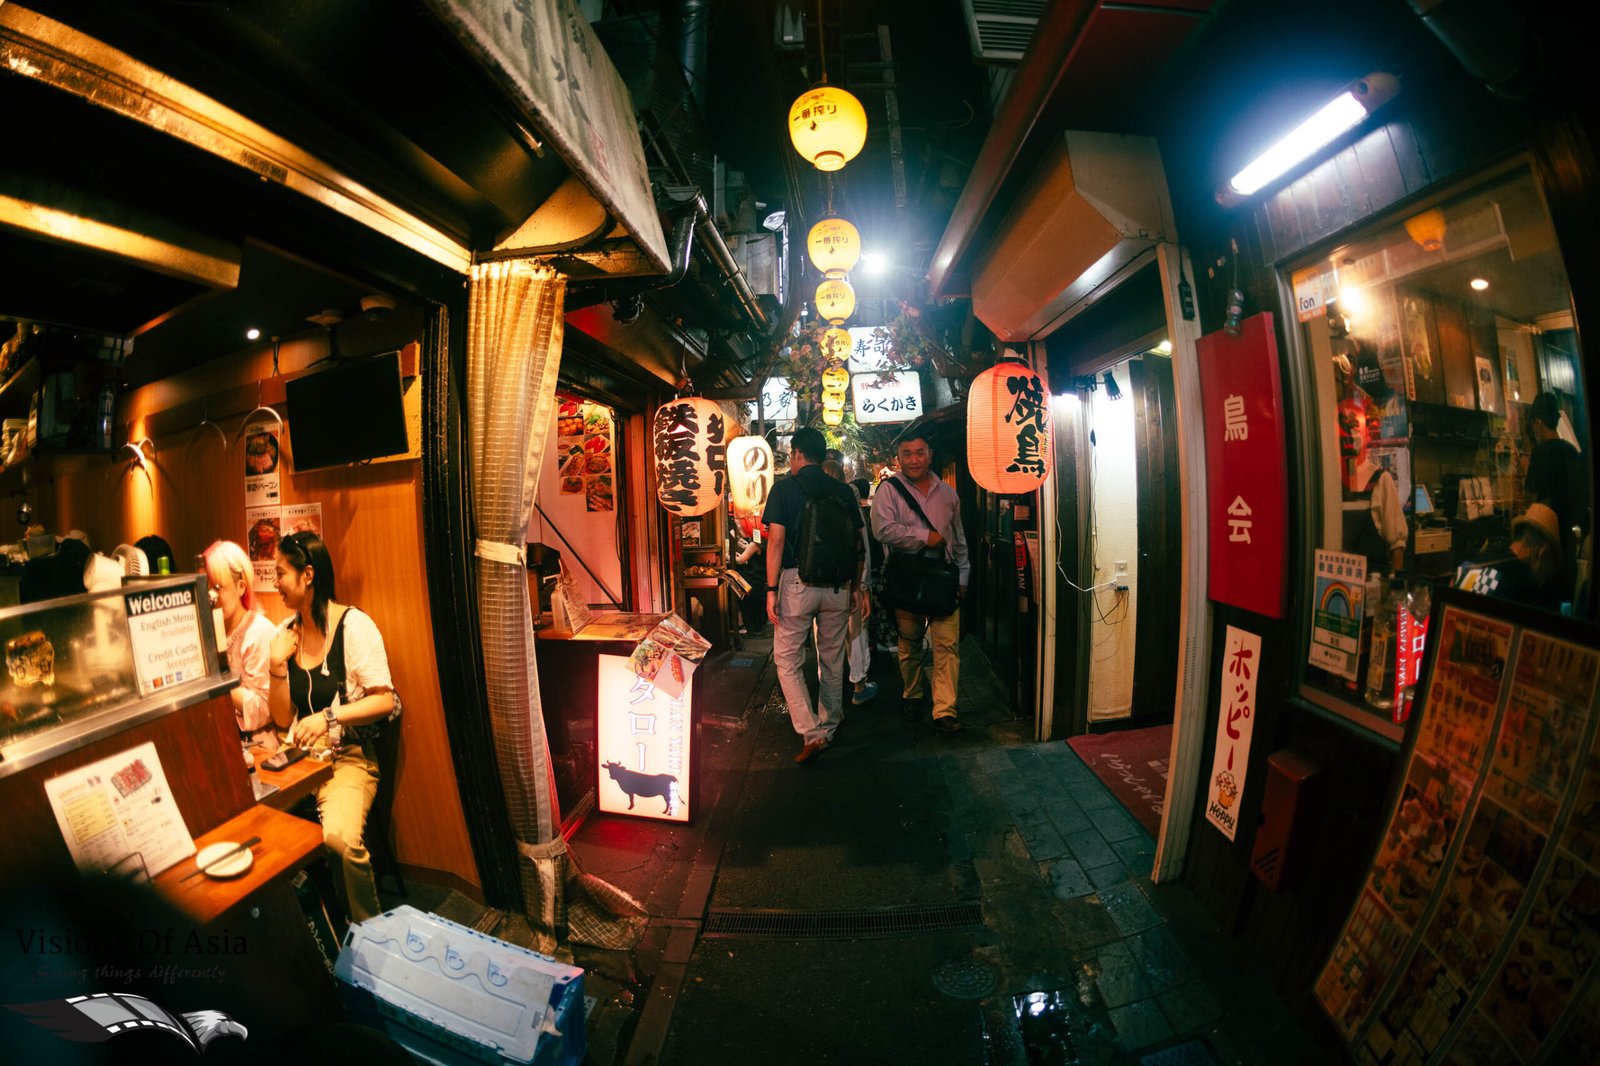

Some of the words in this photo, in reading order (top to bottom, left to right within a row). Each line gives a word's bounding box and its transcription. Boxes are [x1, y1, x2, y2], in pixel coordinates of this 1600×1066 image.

[793, 104, 837, 122] 一番搾り
[815, 235, 849, 246] 一番搾り
[862, 395, 917, 413] らくがき
[1004, 374, 1048, 479] 焼鳥
[128, 590, 192, 615] Welcome
[140, 618, 172, 632] English
[173, 612, 195, 623] Menu
[148, 649, 174, 664] Credit
[175, 642, 198, 655] Cards
[1226, 636, 1254, 771] ホッピー
[627, 675, 658, 771] タロー
